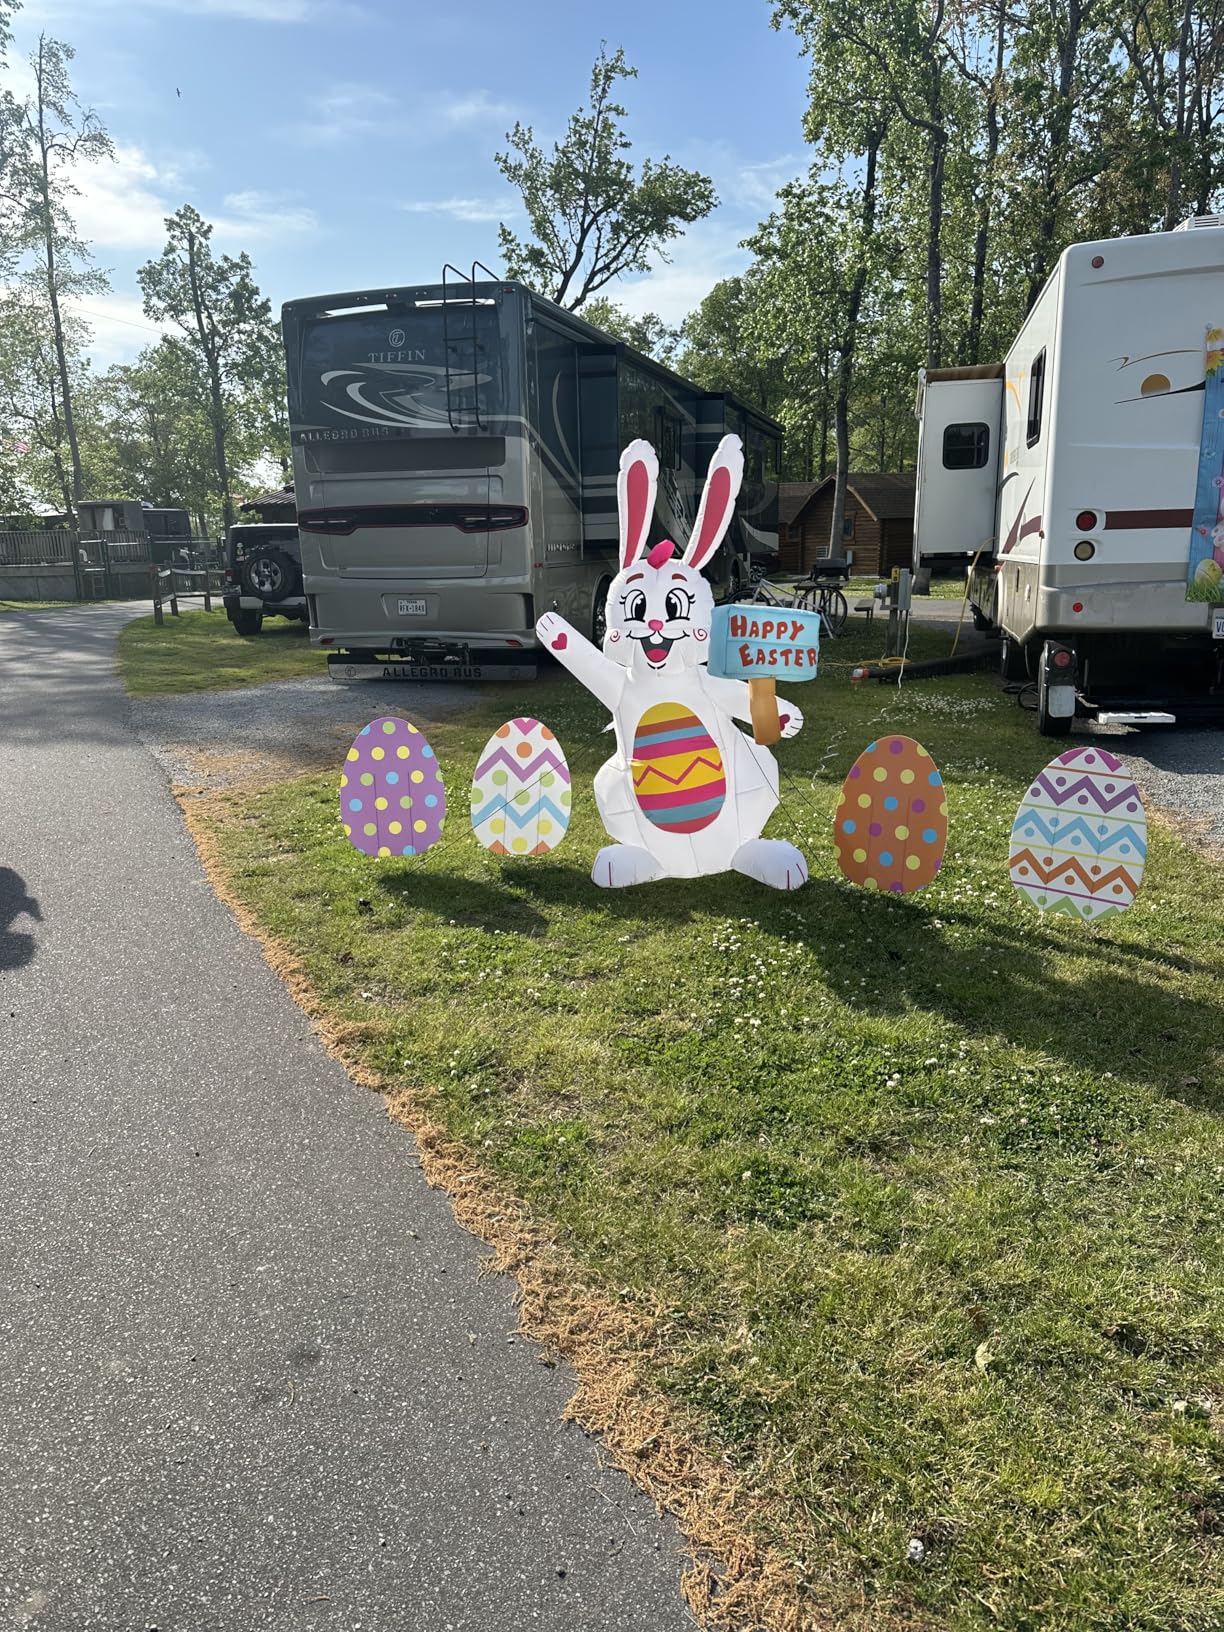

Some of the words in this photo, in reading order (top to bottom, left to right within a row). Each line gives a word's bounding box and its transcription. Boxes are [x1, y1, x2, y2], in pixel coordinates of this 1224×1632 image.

[367, 349, 426, 363] TIFFIN
[300, 429, 358, 441] ALLEGRO
[361, 426, 389, 438] BUS
[730, 614, 805, 642] HAPPY
[738, 642, 817, 668] EASTER
[382, 666, 448, 678] ALLEGRO
[453, 666, 482, 678] BUS
